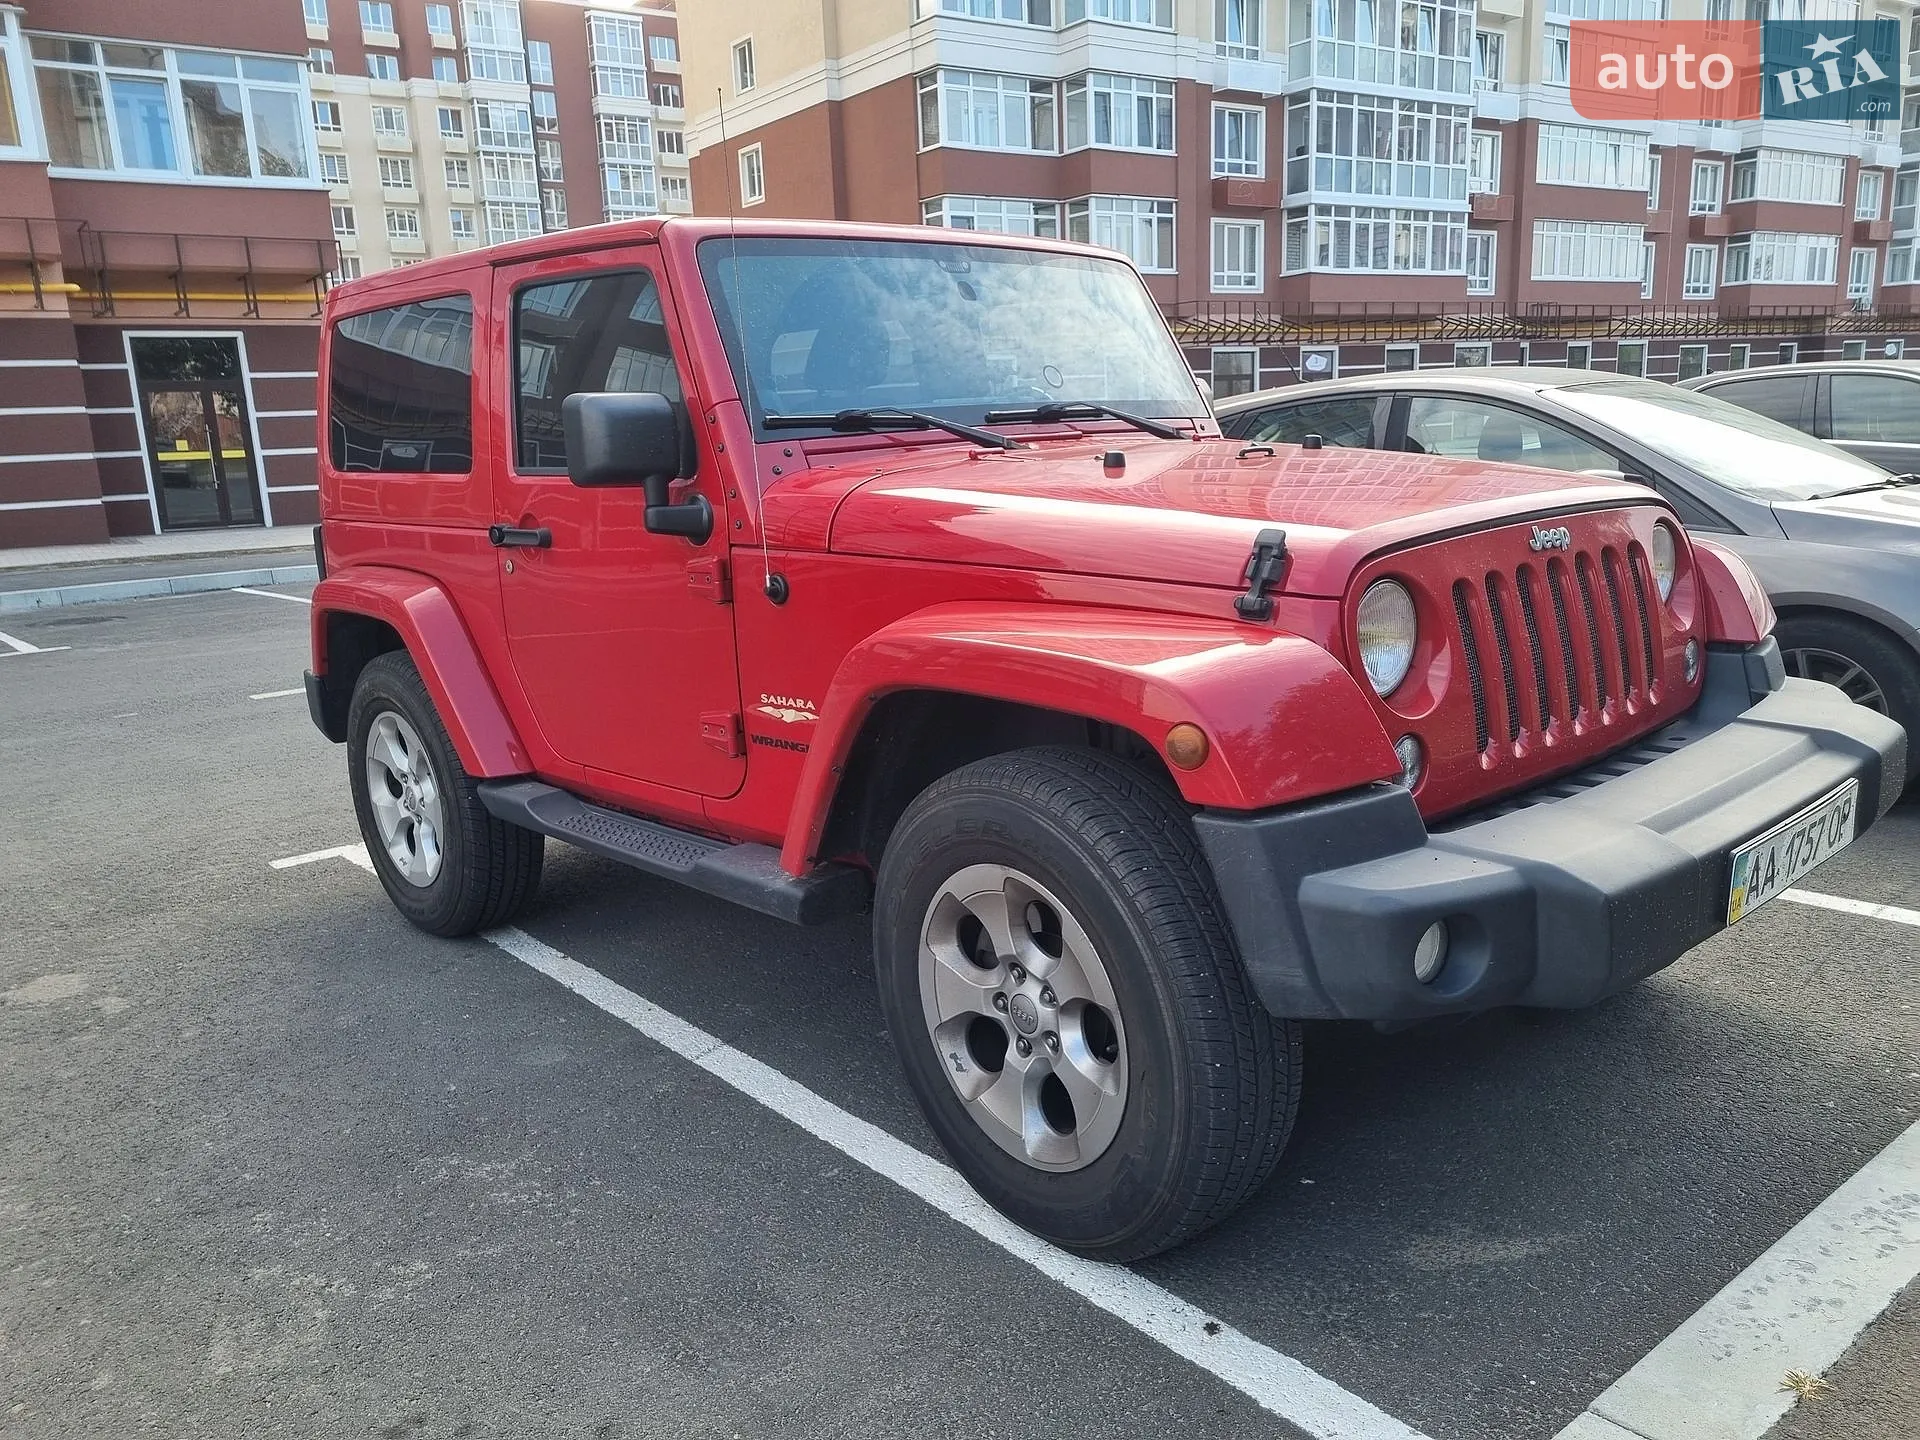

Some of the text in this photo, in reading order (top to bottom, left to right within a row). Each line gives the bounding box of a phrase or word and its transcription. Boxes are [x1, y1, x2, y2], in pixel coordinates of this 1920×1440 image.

[1529, 525, 1571, 552] Jeep
[760, 693, 815, 710] SAHARA
[1744, 797, 1852, 907] AA 1757 OP
